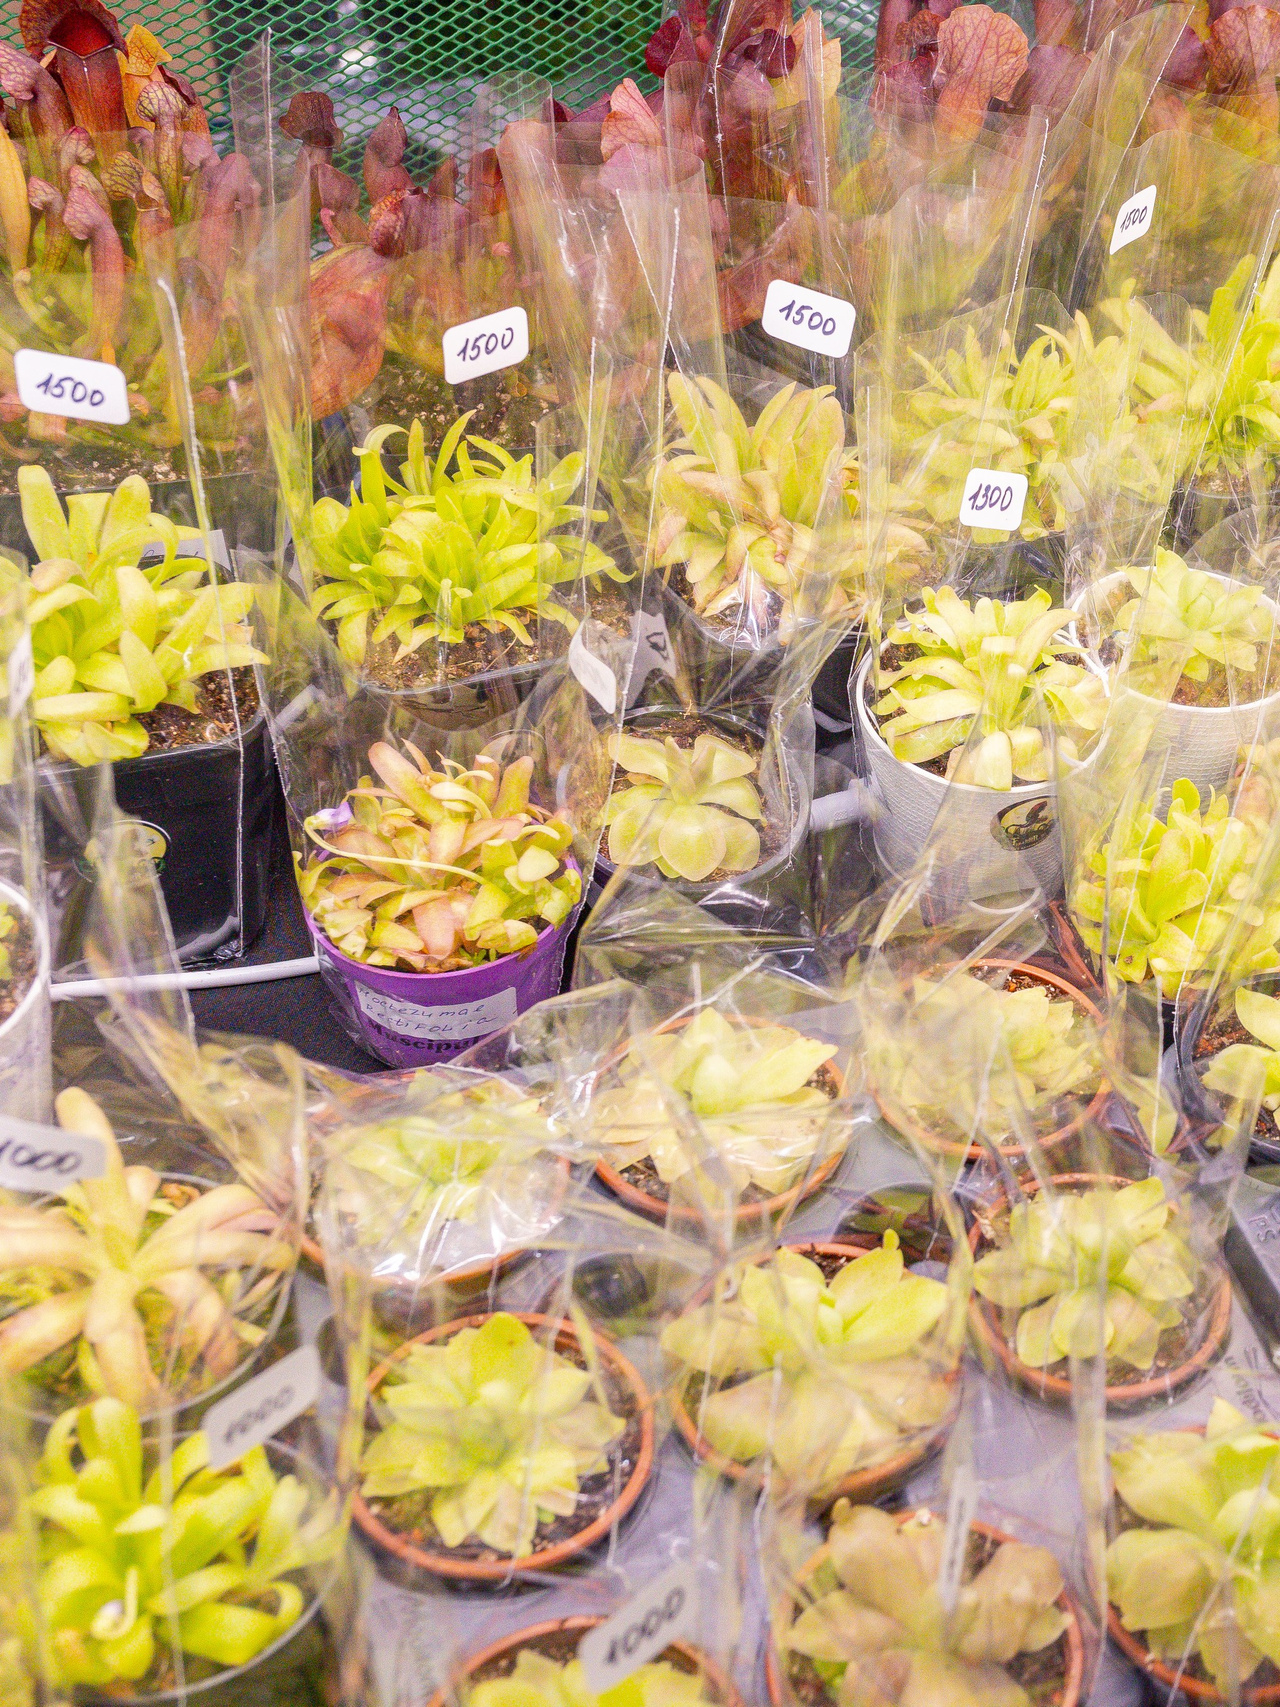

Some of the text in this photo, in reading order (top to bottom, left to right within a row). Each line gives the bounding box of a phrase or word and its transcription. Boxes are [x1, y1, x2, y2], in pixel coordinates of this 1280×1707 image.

[1119, 204, 1149, 233] 1500
[778, 299, 838, 338] 1500
[456, 326, 516, 363] 1500
[35, 372, 106, 409] 1500
[968, 481, 1014, 512] 1300
[604, 1585, 686, 1666] 1000
